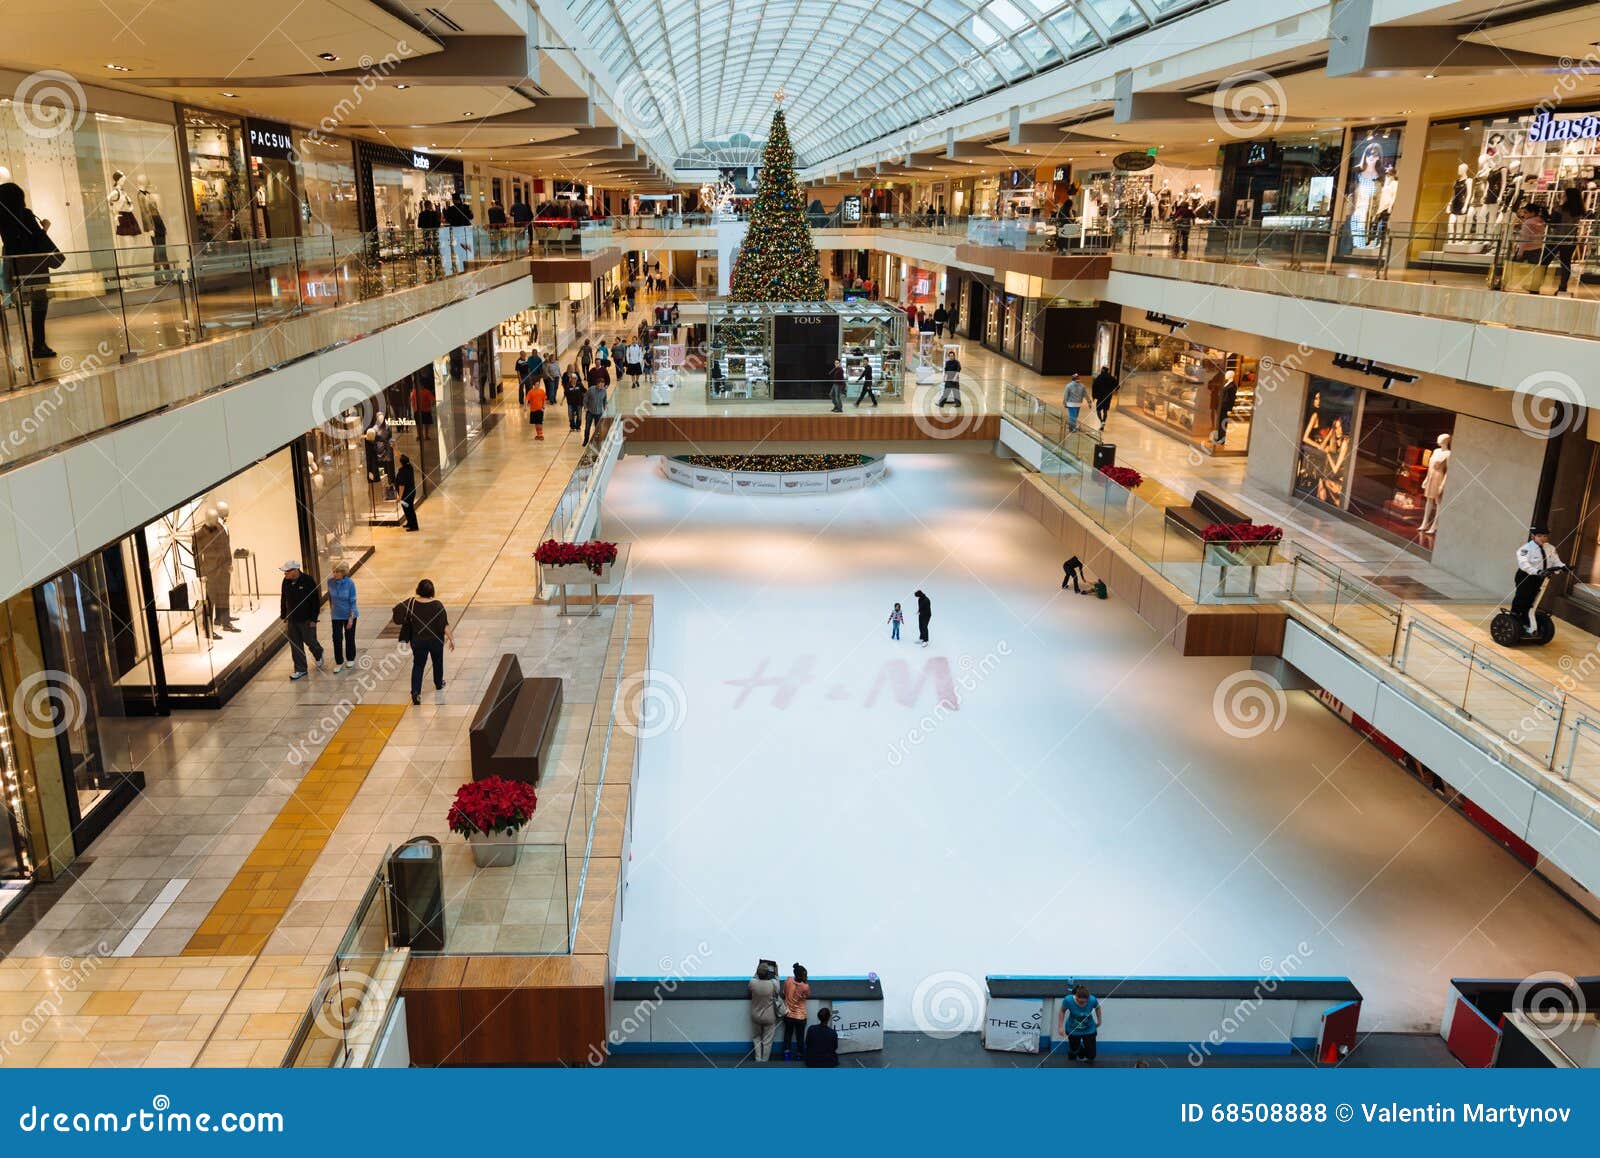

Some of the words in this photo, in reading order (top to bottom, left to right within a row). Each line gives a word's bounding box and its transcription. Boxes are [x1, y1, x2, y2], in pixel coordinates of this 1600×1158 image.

[1529, 112, 1600, 142] shasa
[250, 130, 291, 149] PACSUN
[413, 153, 430, 169] bebe
[793, 316, 821, 325] TOUS
[989, 1018, 1018, 1029] THE
